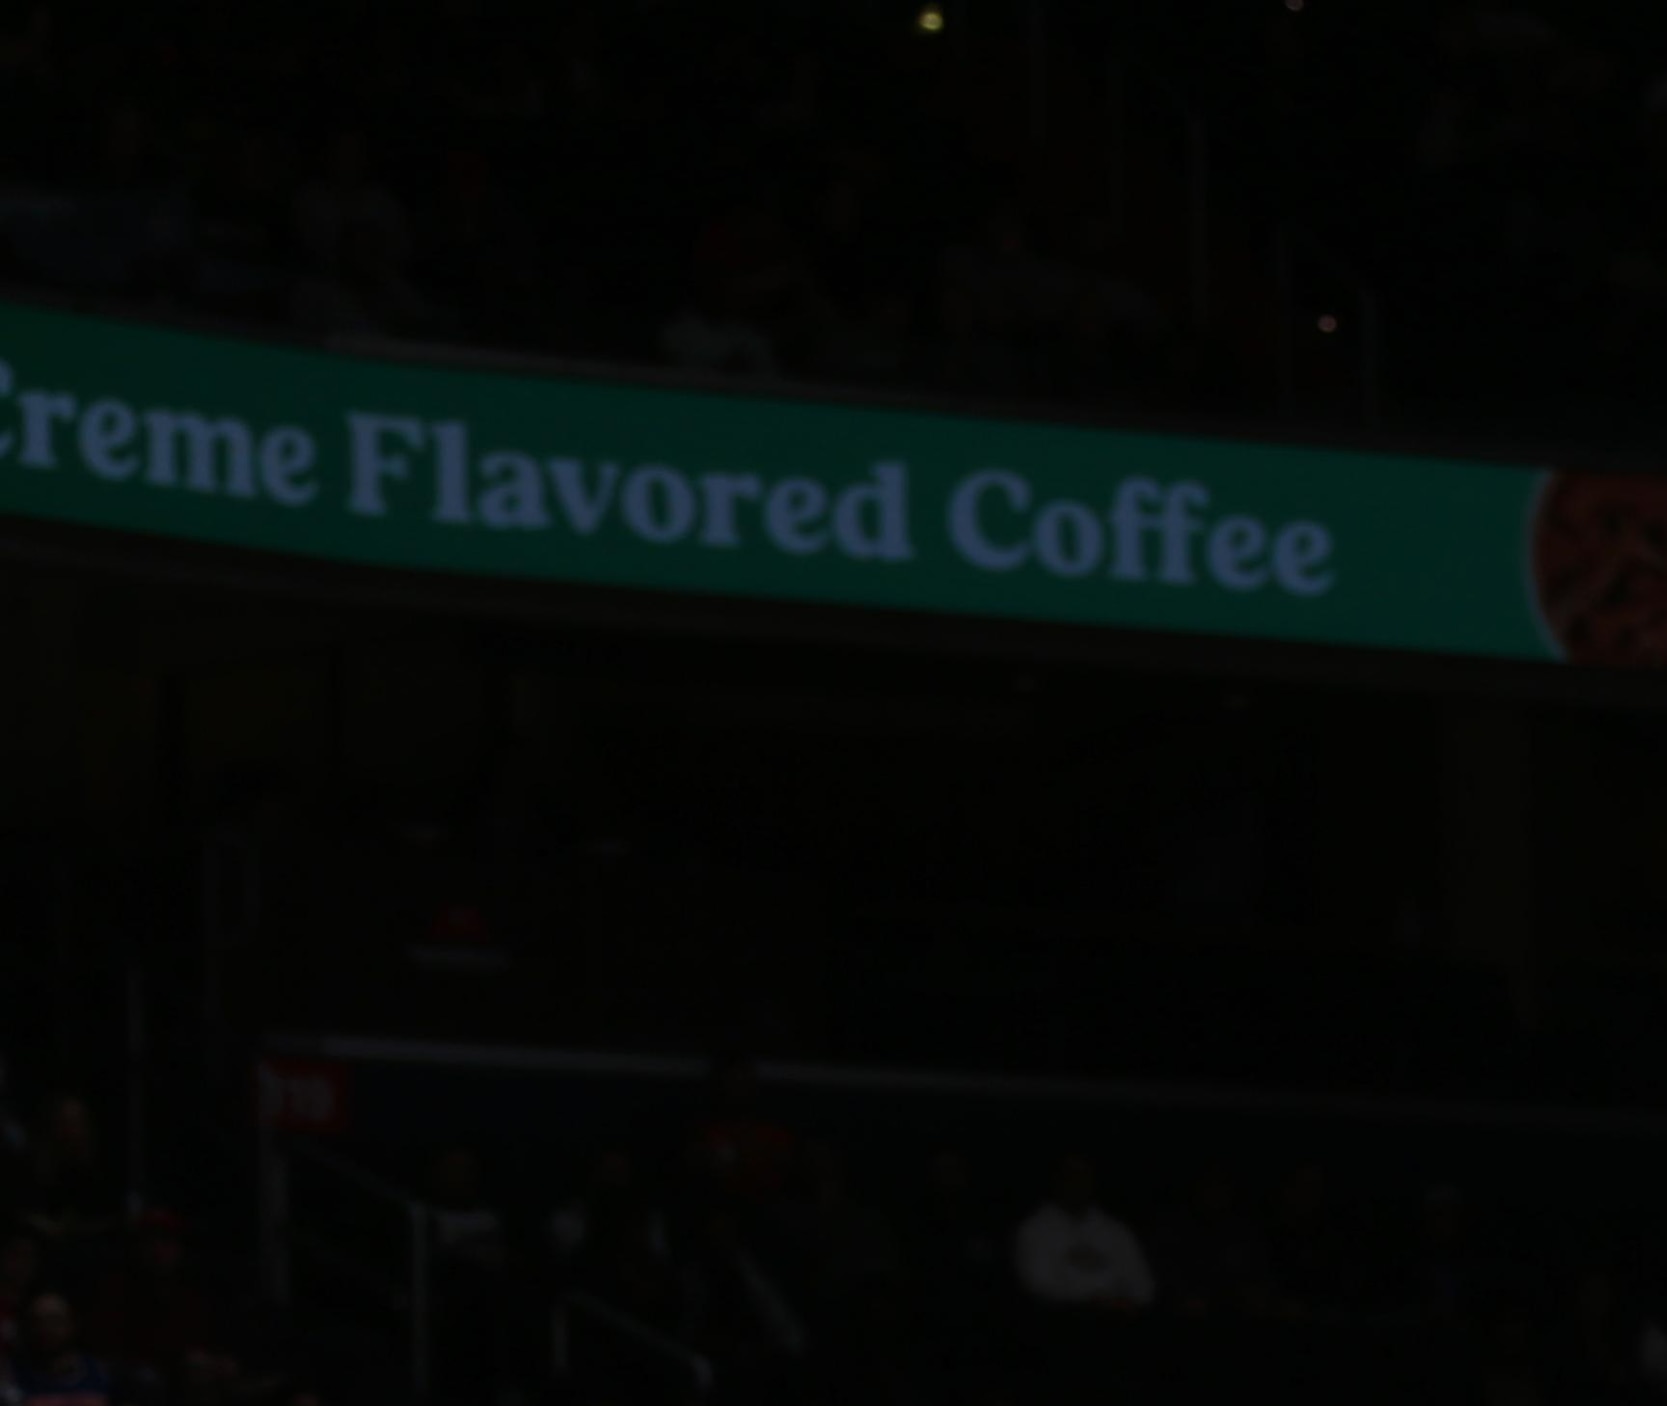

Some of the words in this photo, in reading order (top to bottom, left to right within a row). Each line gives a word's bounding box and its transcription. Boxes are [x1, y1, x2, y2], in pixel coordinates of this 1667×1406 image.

[0, 355, 320, 508] reme
[343, 406, 916, 564] Flavored
[944, 465, 1339, 598] Coffee
